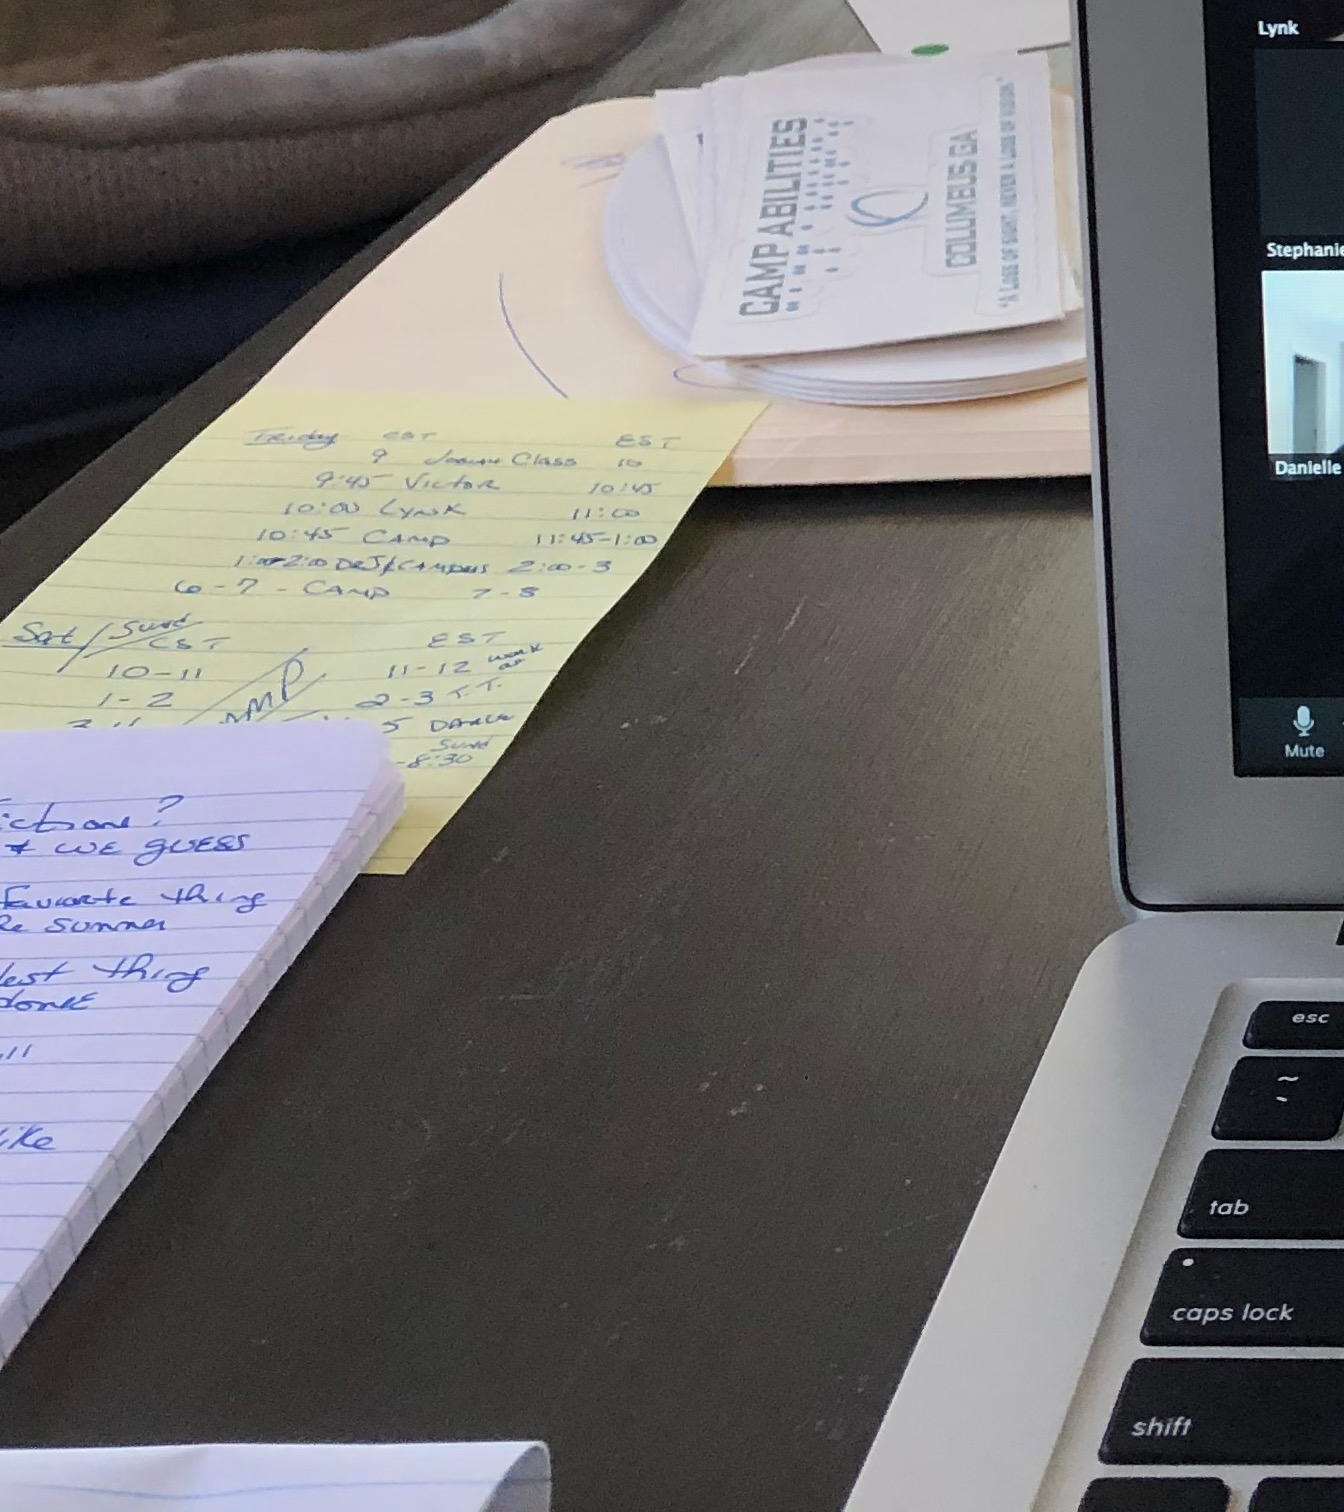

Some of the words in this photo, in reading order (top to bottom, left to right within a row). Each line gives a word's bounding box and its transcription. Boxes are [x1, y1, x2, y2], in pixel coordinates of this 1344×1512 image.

[1258, 20, 1299, 39] Lynk
[948, 128, 979, 157] GA
[756, 117, 808, 237] ABILITIES
[944, 159, 978, 269] COLUMBUS
[738, 243, 789, 317] CAMP
[1275, 459, 1342, 476] Danielle
[1284, 743, 1325, 758] Mute
[1292, 1013, 1330, 1024] esc
[1209, 1198, 1249, 1216] tab
[1171, 1307, 1234, 1326] caps
[1241, 1303, 1294, 1321] lock
[1131, 1416, 1192, 1437] shift
